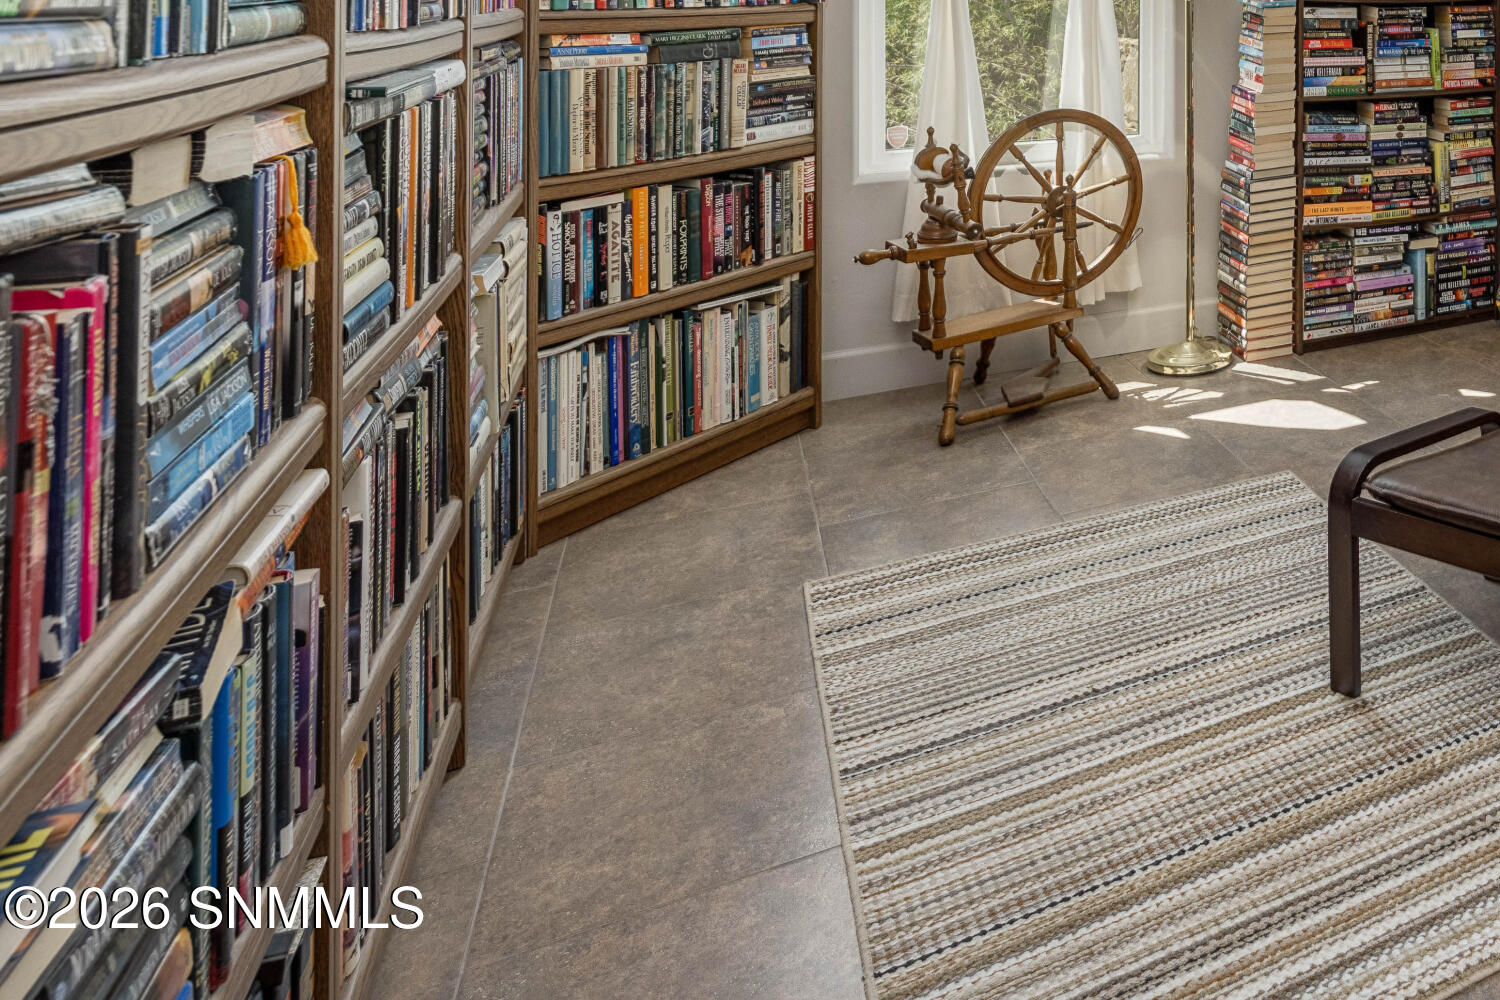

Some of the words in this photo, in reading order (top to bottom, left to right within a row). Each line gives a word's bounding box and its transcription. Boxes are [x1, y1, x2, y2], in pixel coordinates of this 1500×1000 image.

[551, 233, 560, 259] HOT
[611, 220, 620, 283] AGATITE
[679, 219, 688, 271] FOXPRINTS
[551, 260, 560, 280] ICE
[630, 360, 639, 424] Embroidery
[243, 800, 252, 817] IN
[243, 819, 252, 862] DEATH
